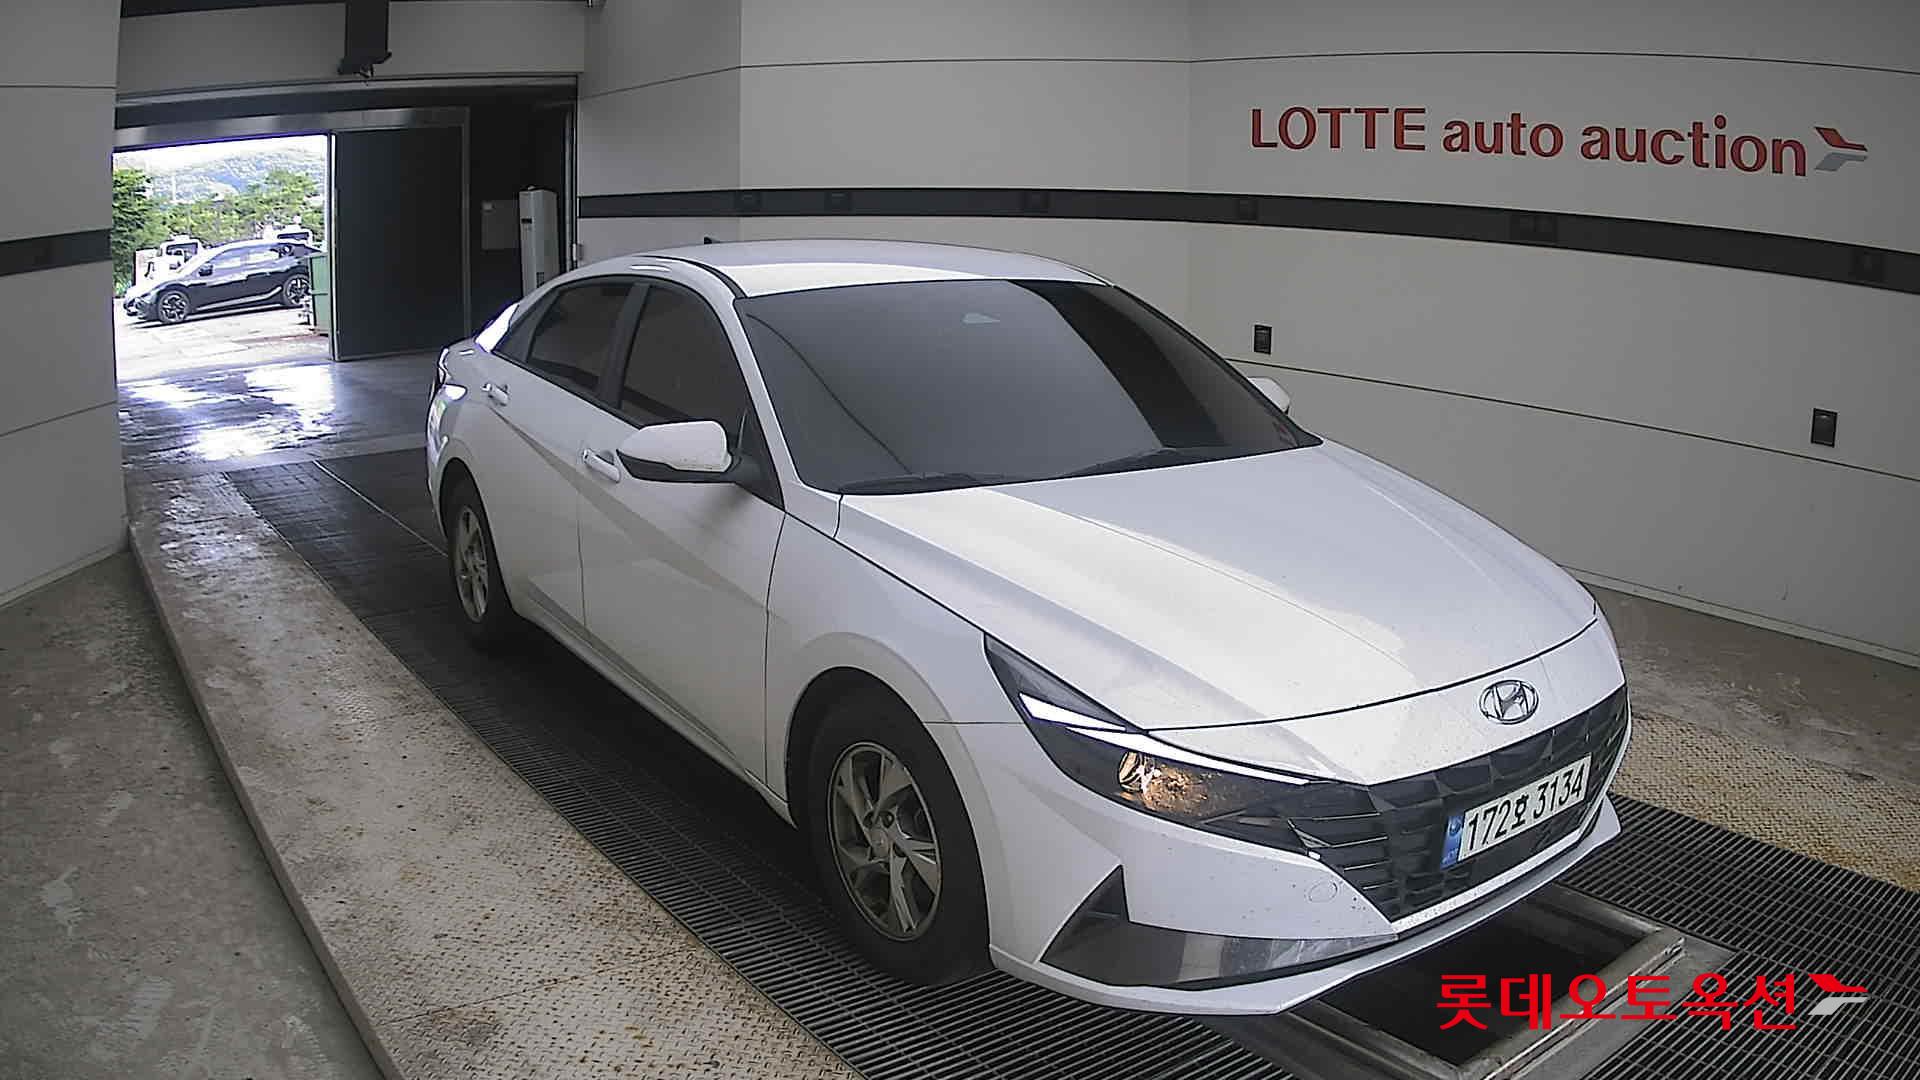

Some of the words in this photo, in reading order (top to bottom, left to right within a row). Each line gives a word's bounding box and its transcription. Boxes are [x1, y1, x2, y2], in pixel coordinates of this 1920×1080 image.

[1251, 106, 1425, 151] LOTTE
[1442, 112, 1563, 158] auto
[1580, 114, 1807, 177] auction
[1468, 794, 1530, 851] 172호
[1533, 763, 1586, 819] 3134
